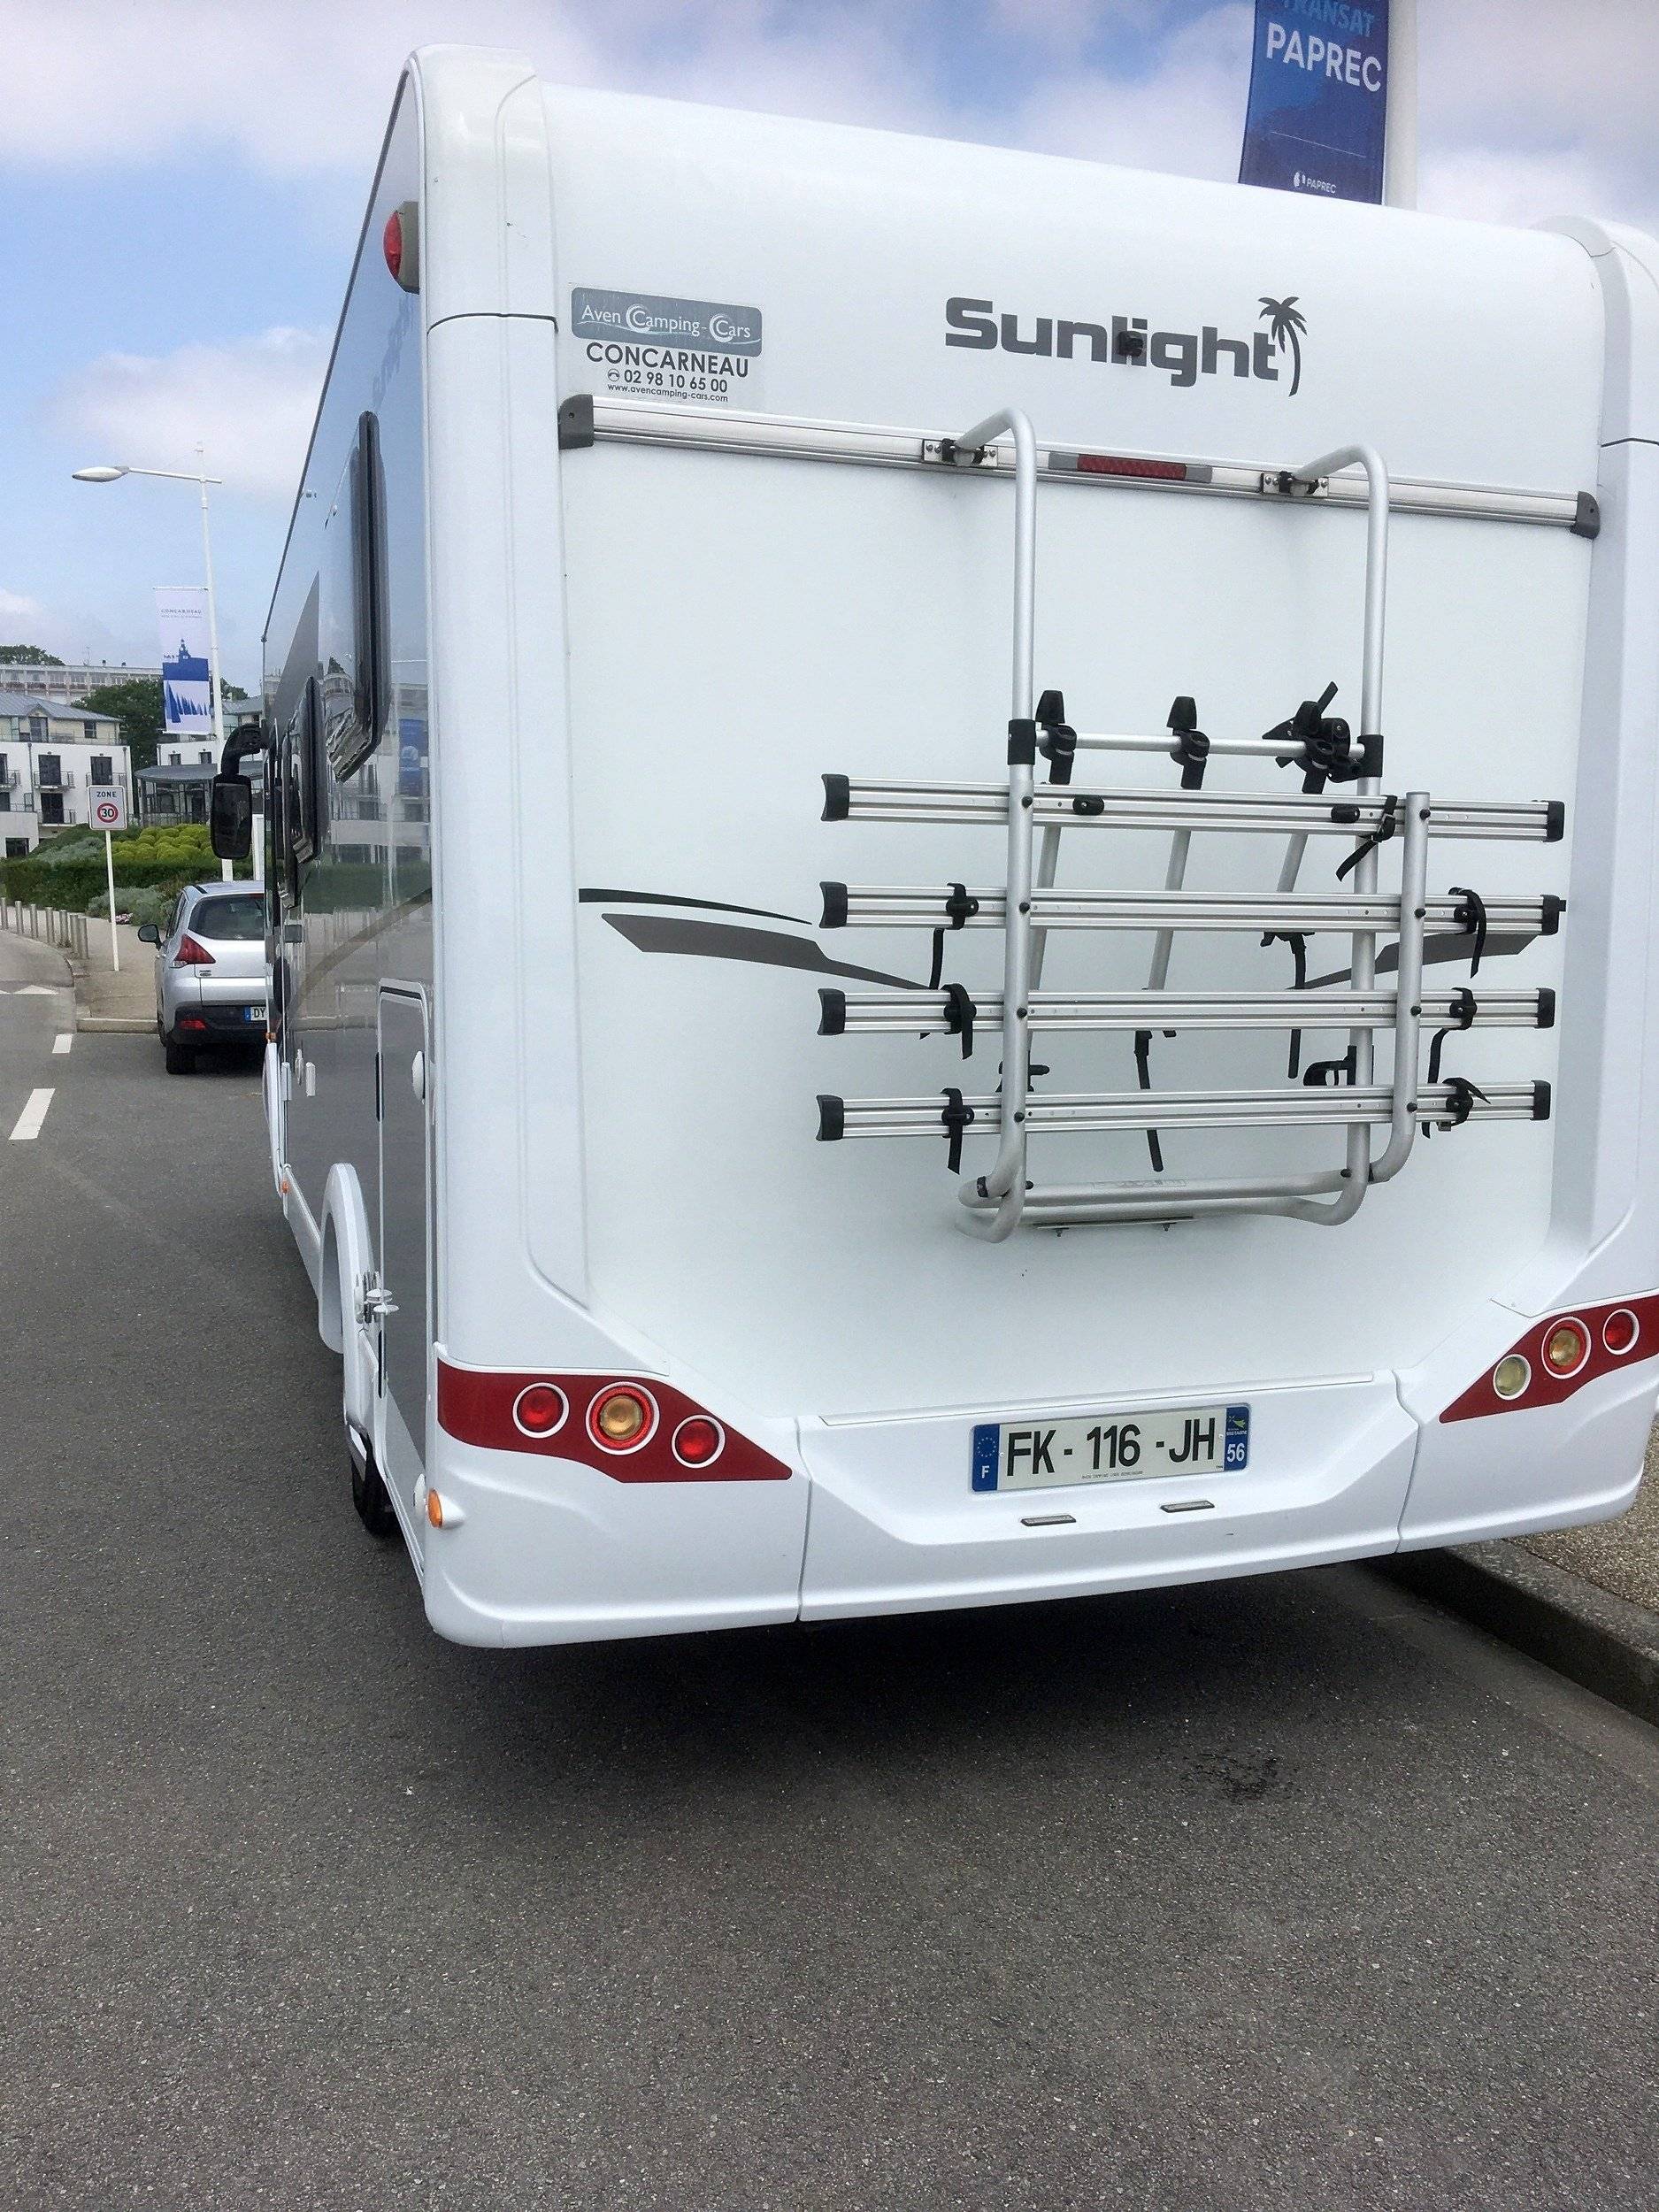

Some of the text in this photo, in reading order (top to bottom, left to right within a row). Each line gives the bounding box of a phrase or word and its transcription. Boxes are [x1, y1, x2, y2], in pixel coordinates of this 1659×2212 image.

[1266, 22, 1382, 92] PAPREC
[1306, 178, 1336, 194] PAPREC
[581, 305, 621, 324] Aven
[946, 296, 1279, 388] Sunlight
[586, 342, 749, 378] CONCARNEAU
[624, 370, 727, 393] 02 98 10 65 00
[607, 383, 728, 403] www.avencamping-cars.com
[101, 808, 114, 818] 30
[1226, 1442, 1245, 1463] 56
[981, 1465, 991, 1479] F
